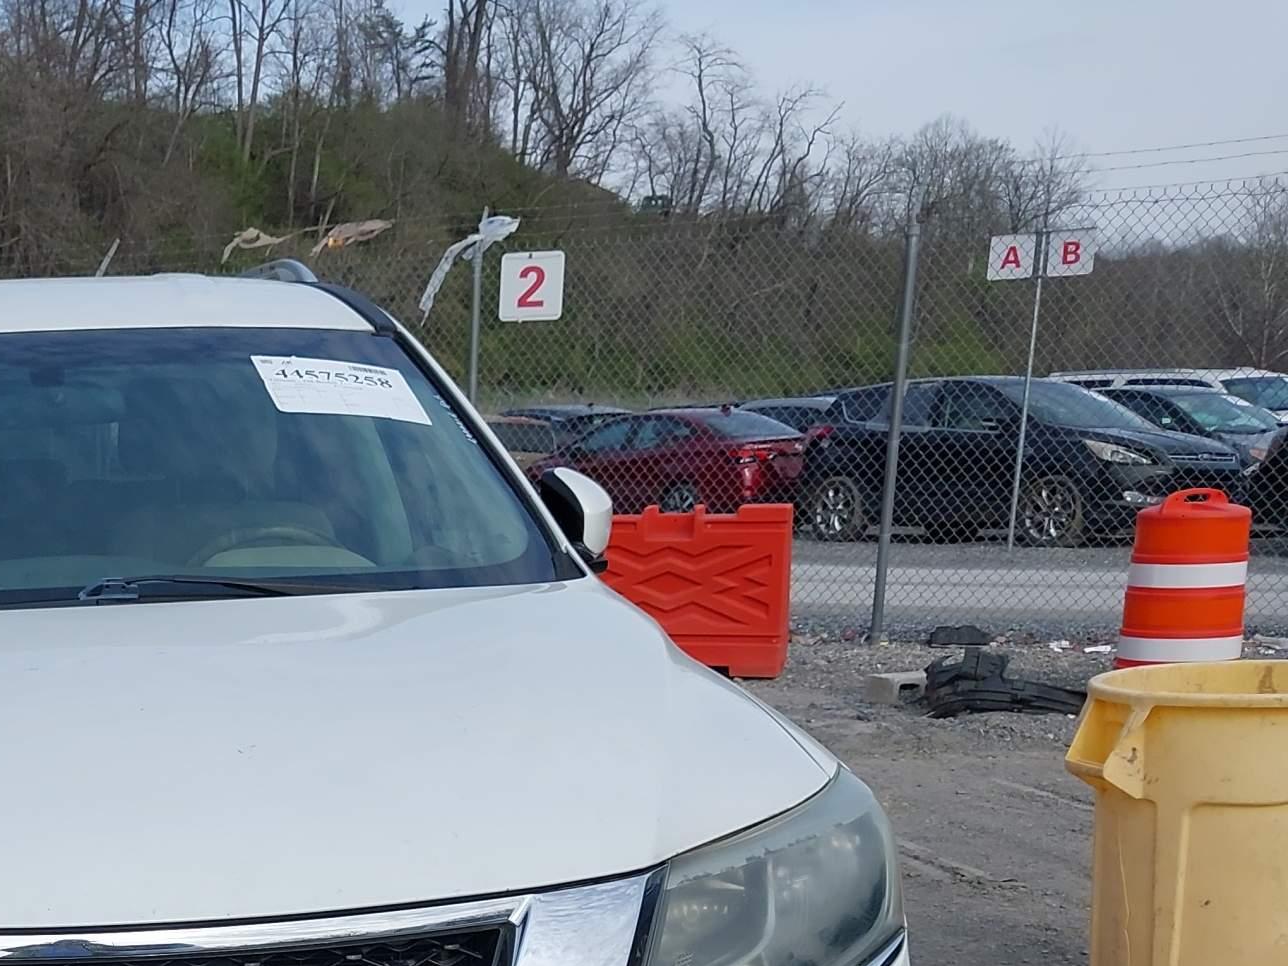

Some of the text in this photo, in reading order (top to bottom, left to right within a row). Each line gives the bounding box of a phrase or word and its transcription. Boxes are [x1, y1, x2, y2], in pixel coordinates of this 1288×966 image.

[1000, 246, 1021, 270] A
[1062, 241, 1081, 265] B
[517, 265, 545, 308] 2
